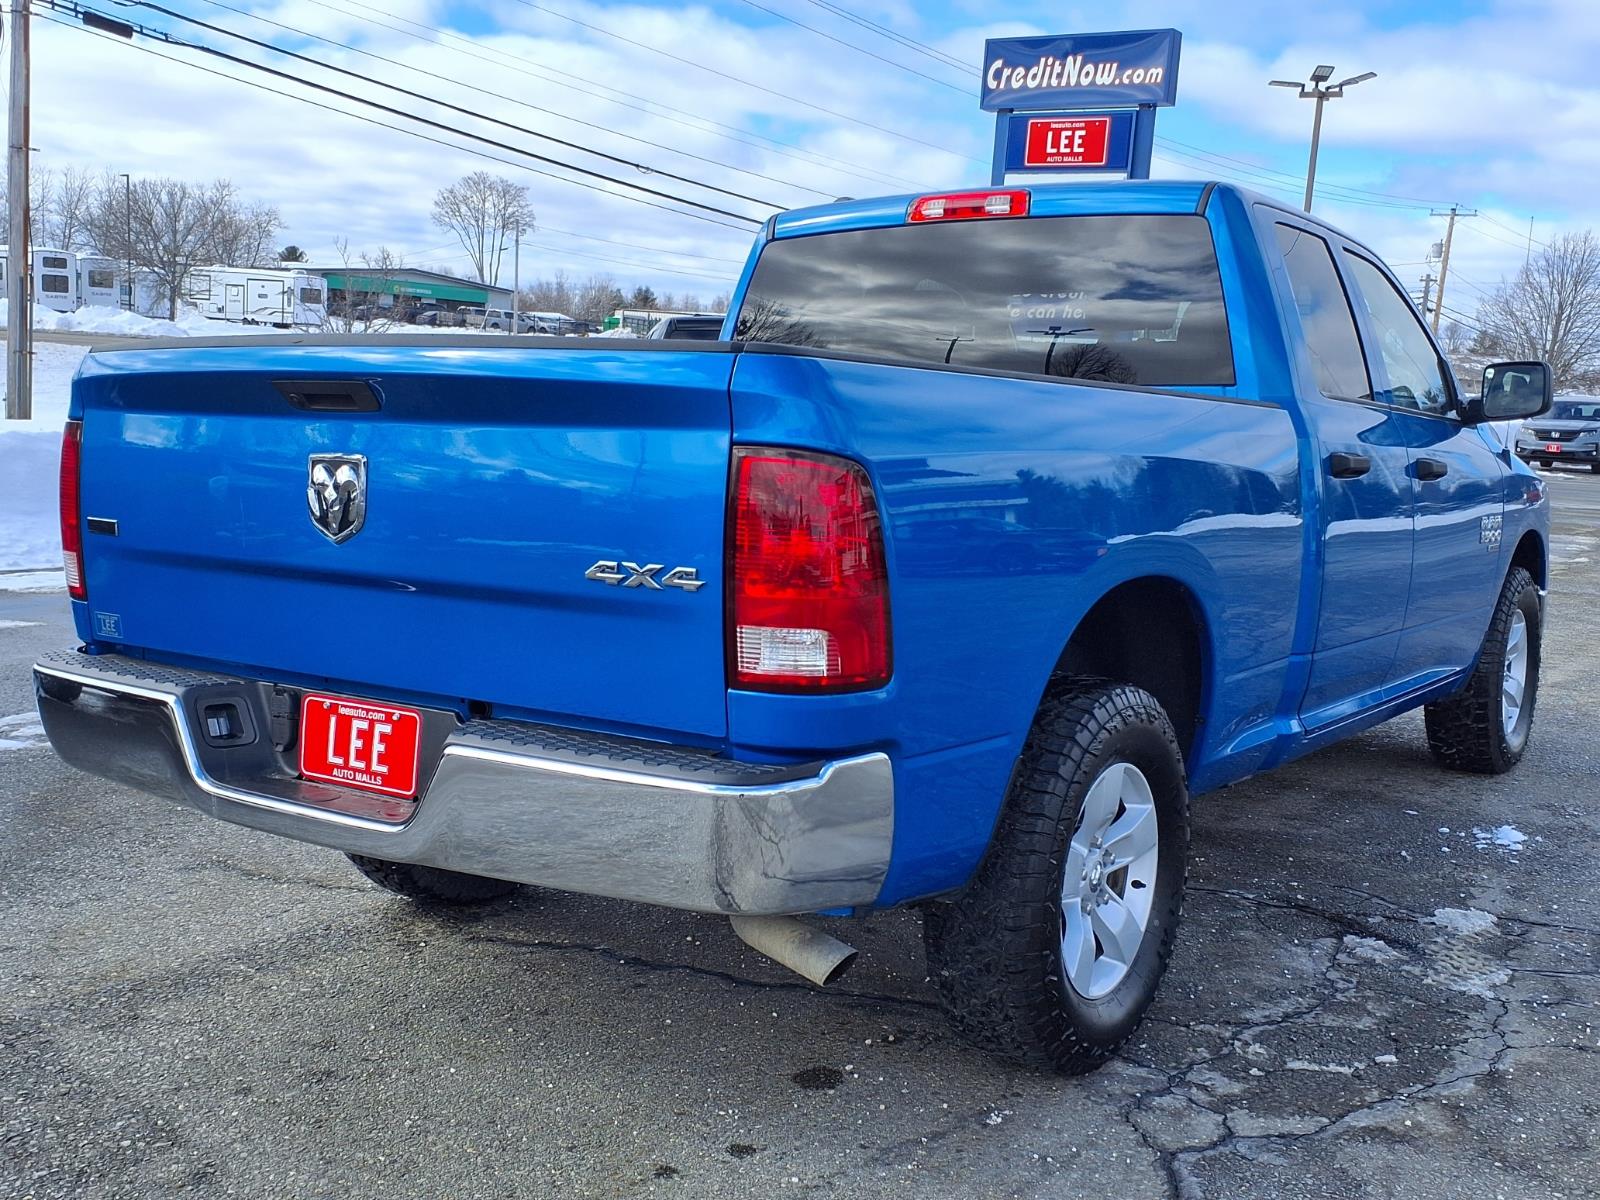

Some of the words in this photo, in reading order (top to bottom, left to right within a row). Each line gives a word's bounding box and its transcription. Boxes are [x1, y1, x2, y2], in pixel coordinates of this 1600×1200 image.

[987, 55, 1163, 90] CreditNow.com
[1046, 130, 1086, 153] LEE
[1027, 307, 1056, 318] can
[101, 618, 116, 631] LEE
[338, 705, 386, 721] leeauto.com
[327, 715, 393, 774] LEE
[332, 767, 354, 780] AUTO
[355, 772, 382, 785] MALLS
